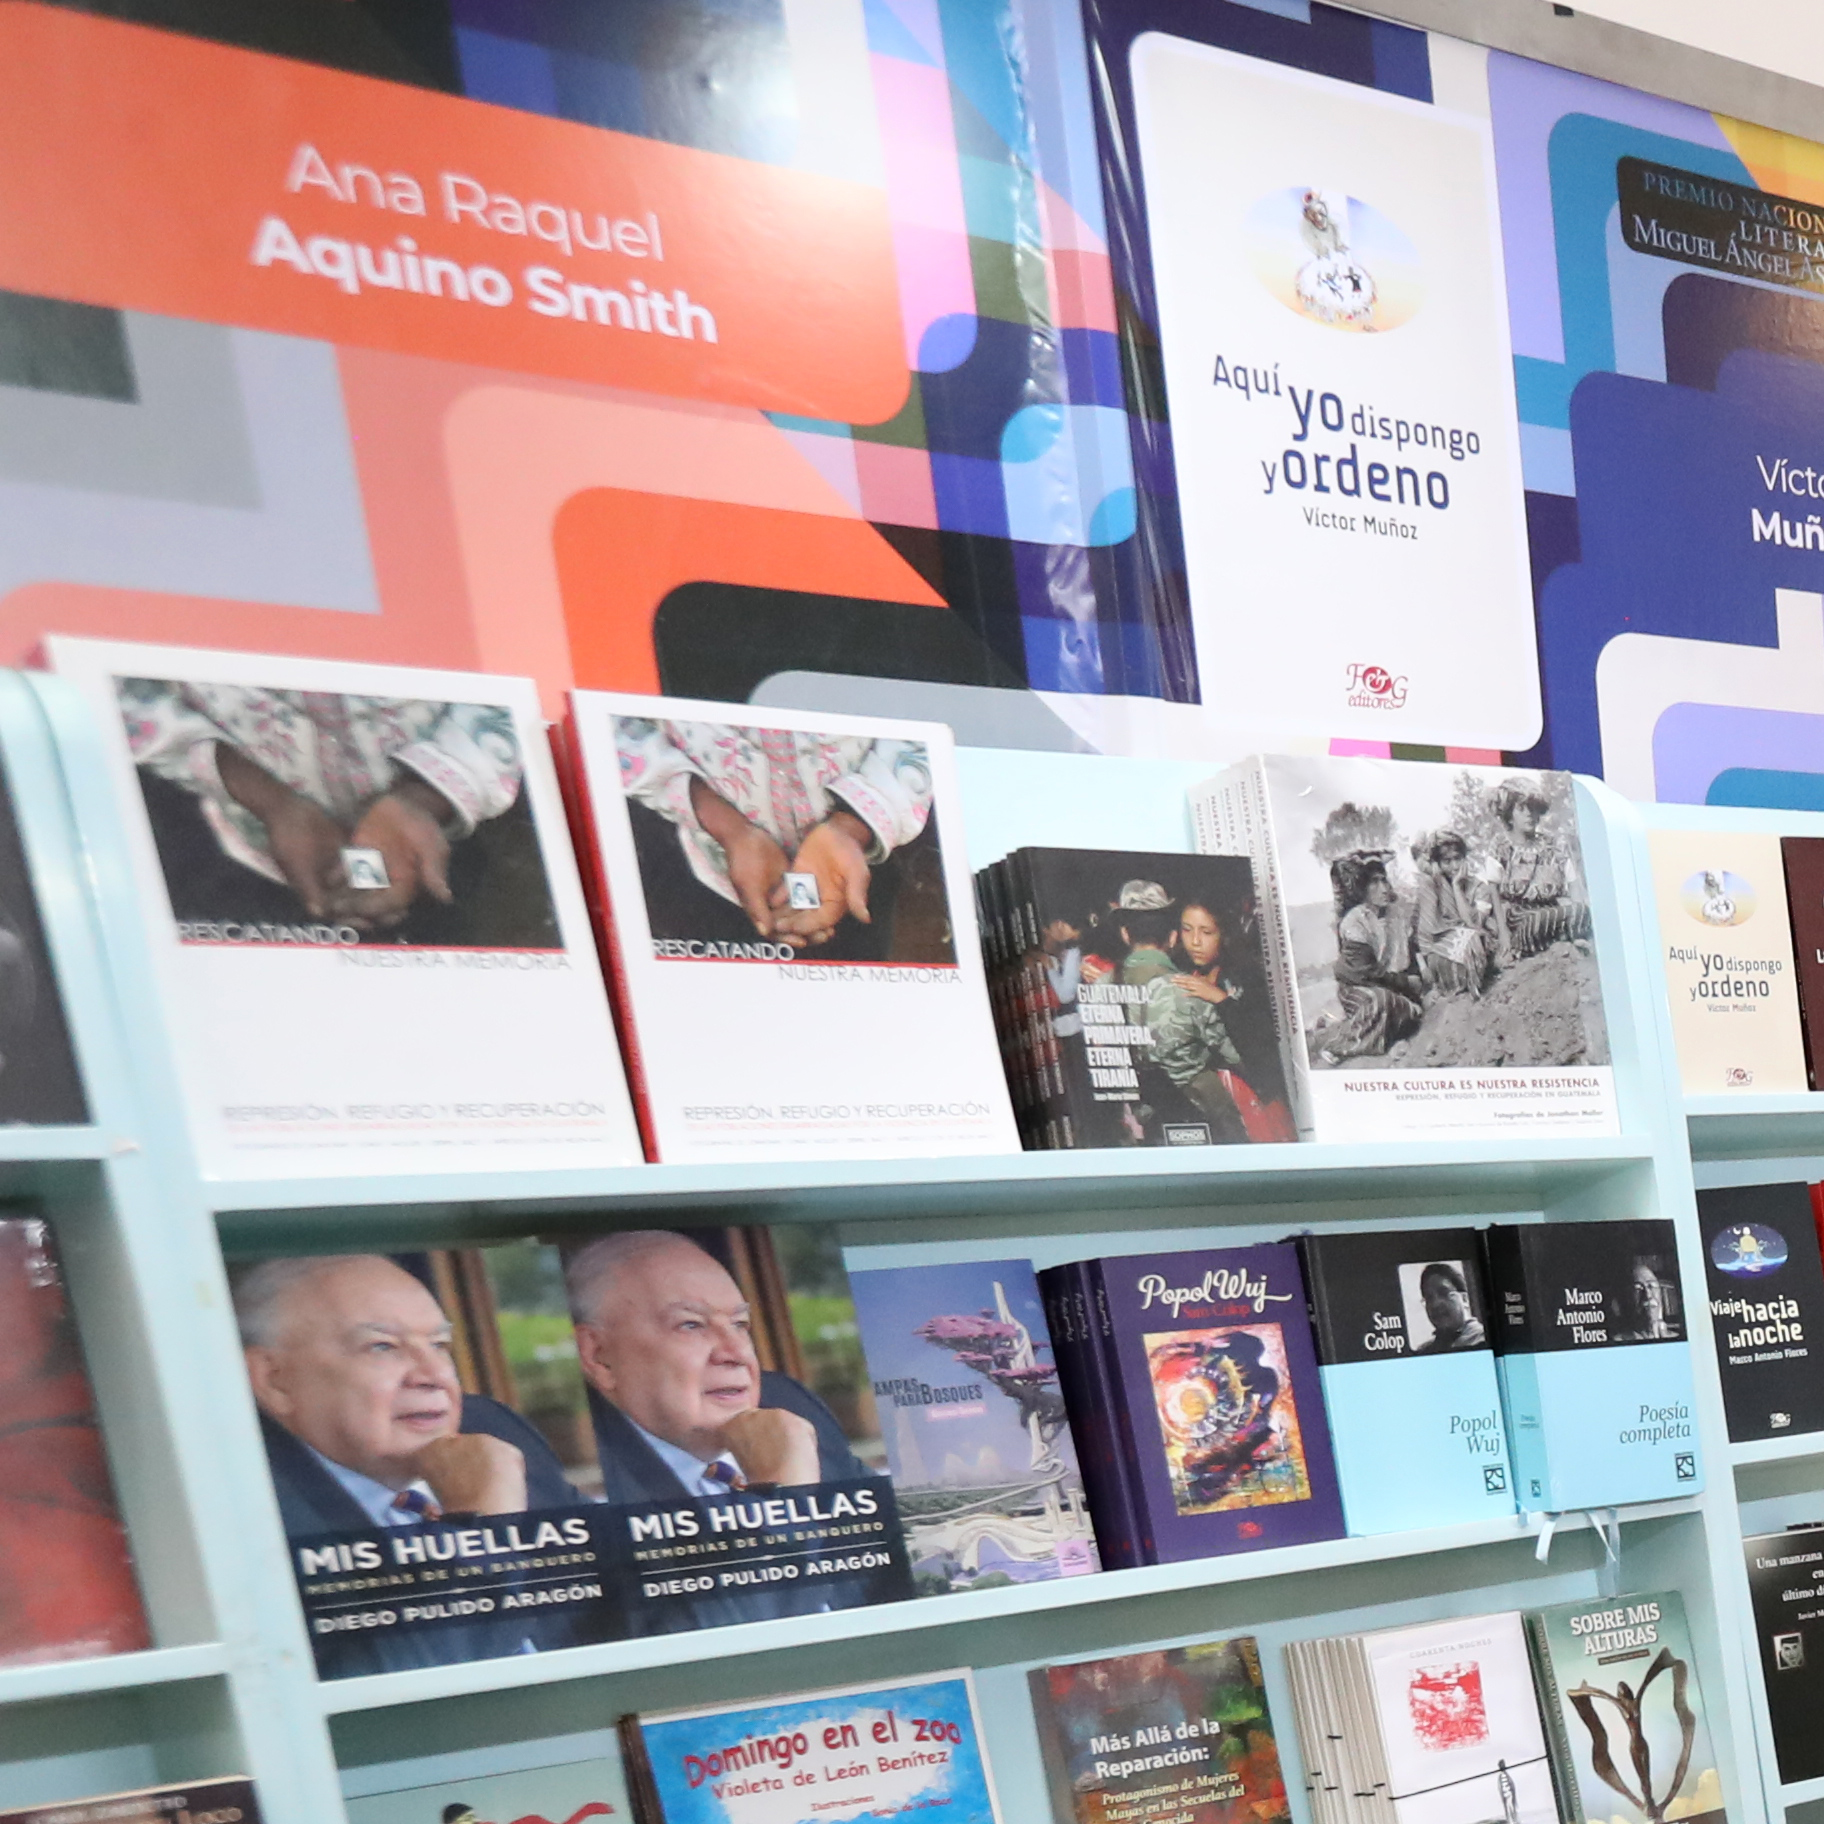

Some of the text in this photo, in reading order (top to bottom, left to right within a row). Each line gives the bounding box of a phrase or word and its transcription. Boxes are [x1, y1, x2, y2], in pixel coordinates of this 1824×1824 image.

[285, 143, 664, 262] Ana Raquel
[1644, 172, 1734, 212] PREMIO
[1632, 215, 1721, 262] MIGUEL
[1726, 233, 1792, 278] ÁNGEL
[251, 215, 719, 345] Aquino Smith
[1211, 354, 1482, 462] Aquí yo dispongo
[1260, 442, 1451, 512] y ordeno
[1302, 505, 1419, 541] Víctor Muñoz
[652, 938, 794, 961] RESCATANDO
[778, 963, 963, 985] NUESTRA MEMORIA
[1079, 1005, 1126, 1025] ETERNA
[1083, 1026, 1157, 1048] PRIMAVERA,
[1086, 1048, 1132, 1067] ETERNA
[1343, 1077, 1600, 1093] NUESTRA CULTURA ES NUESTRA RESISTENCIA
[1138, 1268, 1293, 1319] Popol Wuj
[1565, 1287, 1602, 1306] Marco
[1374, 1312, 1402, 1331] Sam
[1556, 1307, 1605, 1326] Antonio
[1711, 1295, 1799, 1324] Viaje hacia
[1364, 1333, 1404, 1353] Colop
[1573, 1326, 1607, 1344] Flores
[1728, 1320, 1803, 1349] la noche
[1450, 1410, 1498, 1435] Popol
[1639, 1401, 1689, 1423] Poesía
[1466, 1434, 1500, 1455] Wuj
[1619, 1421, 1691, 1447] completa
[628, 1488, 879, 1543] MIS HUELLAS
[643, 1548, 891, 1598] DIEGO PULIDO ARAGÓN
[1569, 1601, 1661, 1637] SOBRE MIS
[1584, 1624, 1658, 1656] ALTURAS
[1089, 1715, 1220, 1756] Más Allá de la
[682, 1711, 963, 1790] Domingo en el zoo
[1095, 1744, 1211, 1780] Reparación:
[711, 1747, 950, 1802] Violeta de León Benítez
